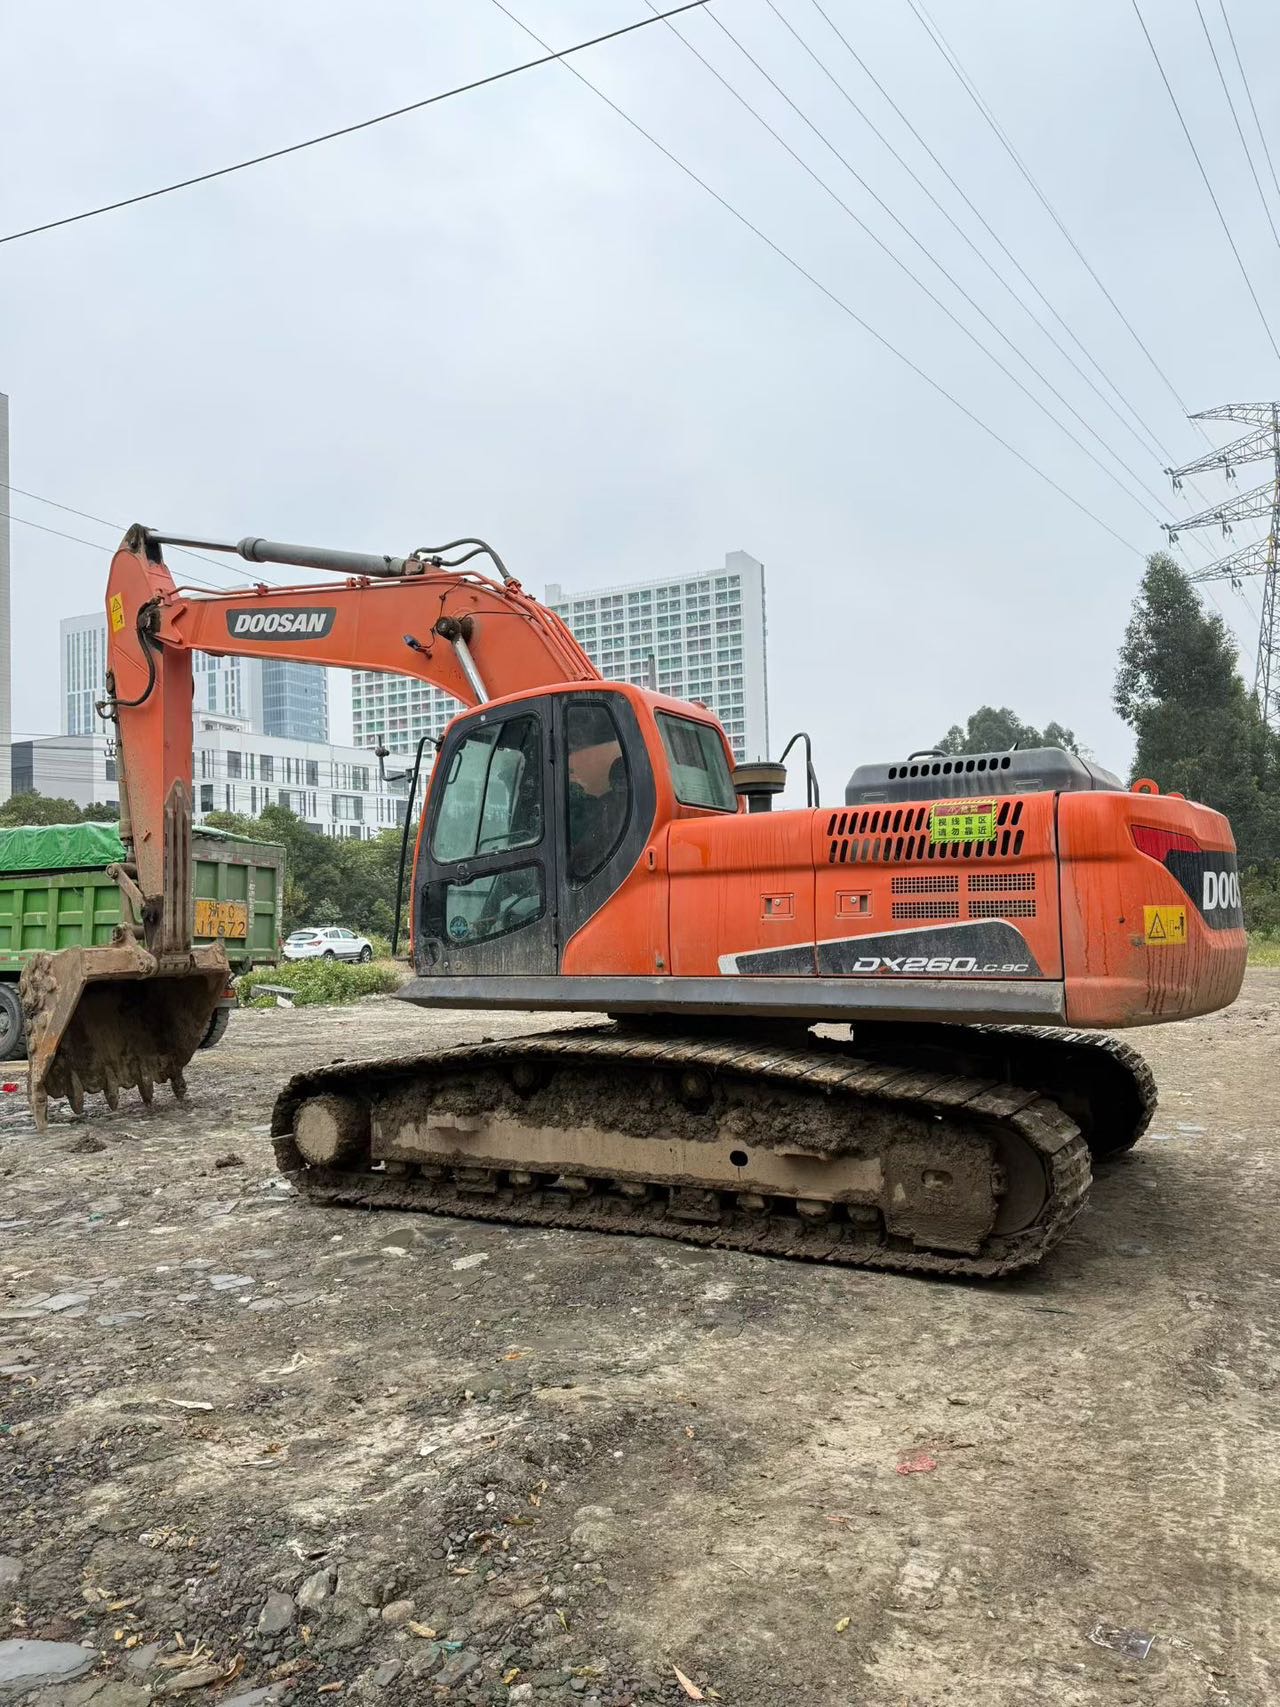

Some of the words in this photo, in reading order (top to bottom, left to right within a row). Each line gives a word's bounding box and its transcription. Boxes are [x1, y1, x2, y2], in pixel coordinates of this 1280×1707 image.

[234, 613, 327, 632] DOOSAN
[938, 816, 987, 826] 视线盲区
[938, 826, 987, 836] 请勿靠近
